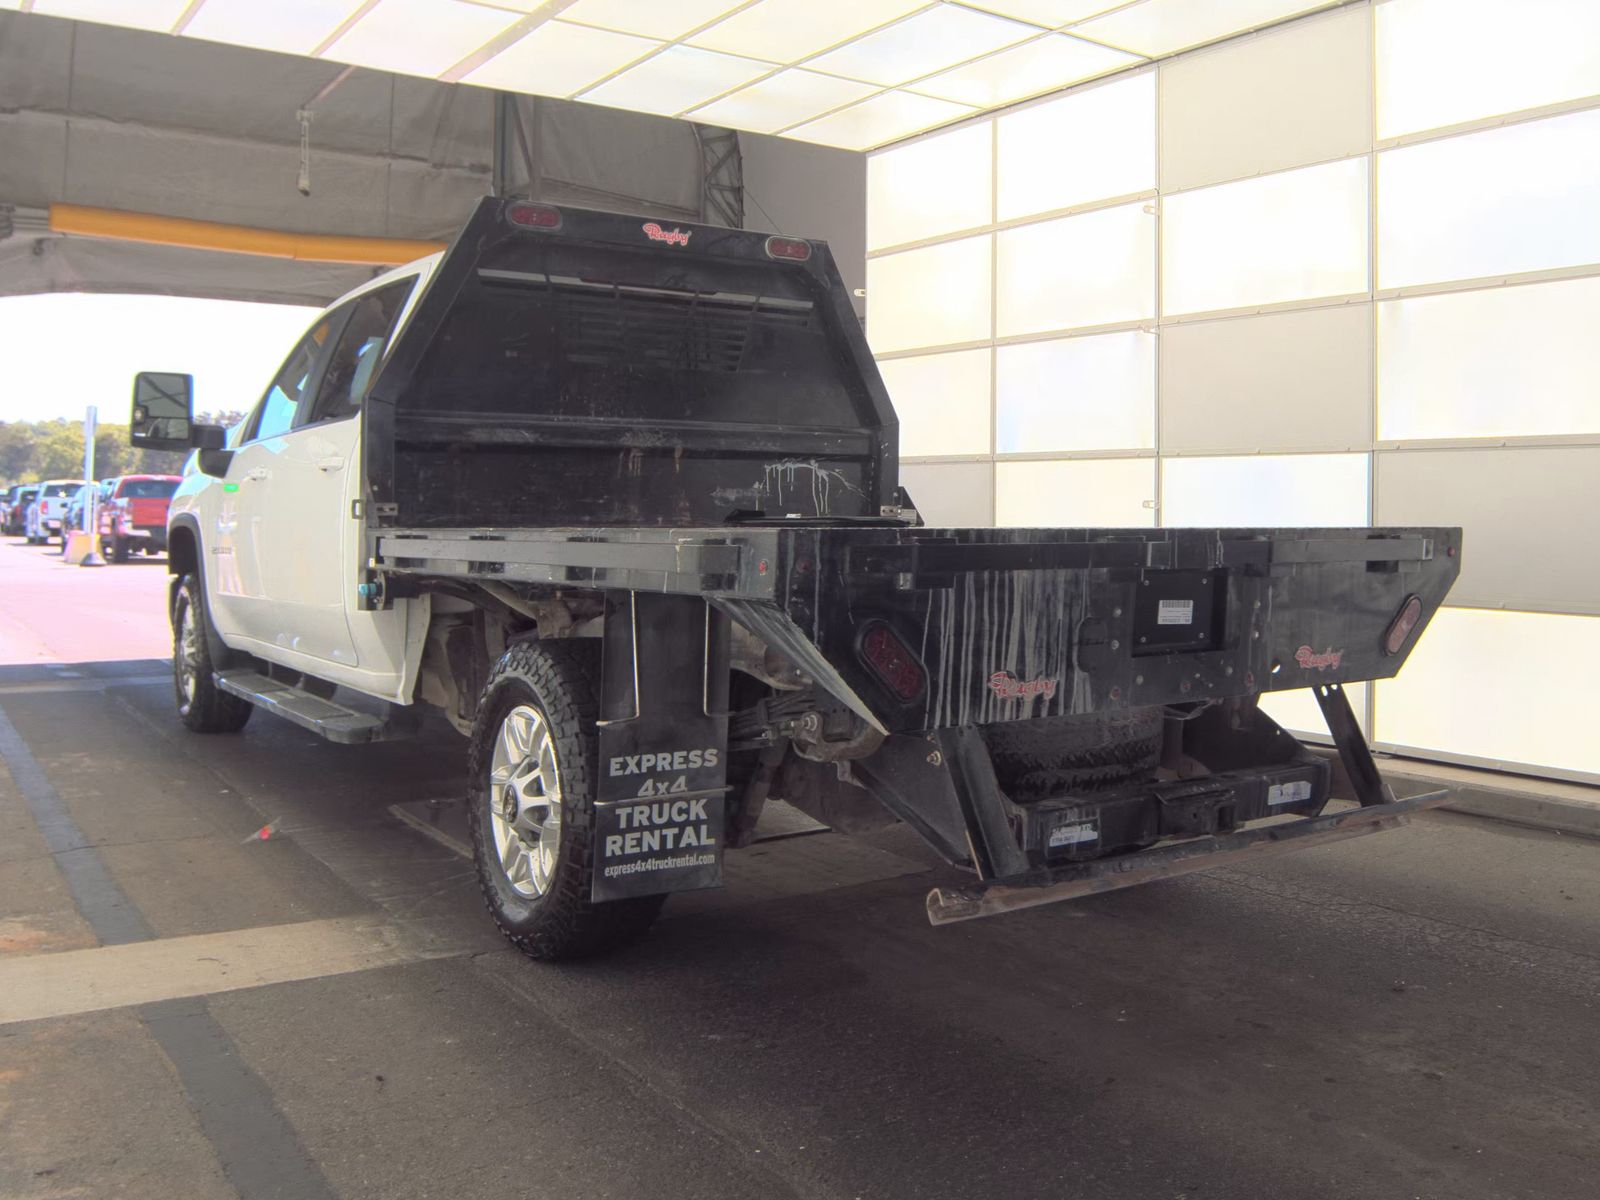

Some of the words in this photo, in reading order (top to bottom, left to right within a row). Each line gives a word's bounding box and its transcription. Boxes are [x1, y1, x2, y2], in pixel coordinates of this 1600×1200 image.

[609, 748, 719, 777] EXPRESS
[637, 775, 688, 797] 4x4
[615, 798, 709, 829] TRUCK
[605, 824, 716, 857] RENTAL
[604, 853, 715, 878] express4x4truckrental.com
